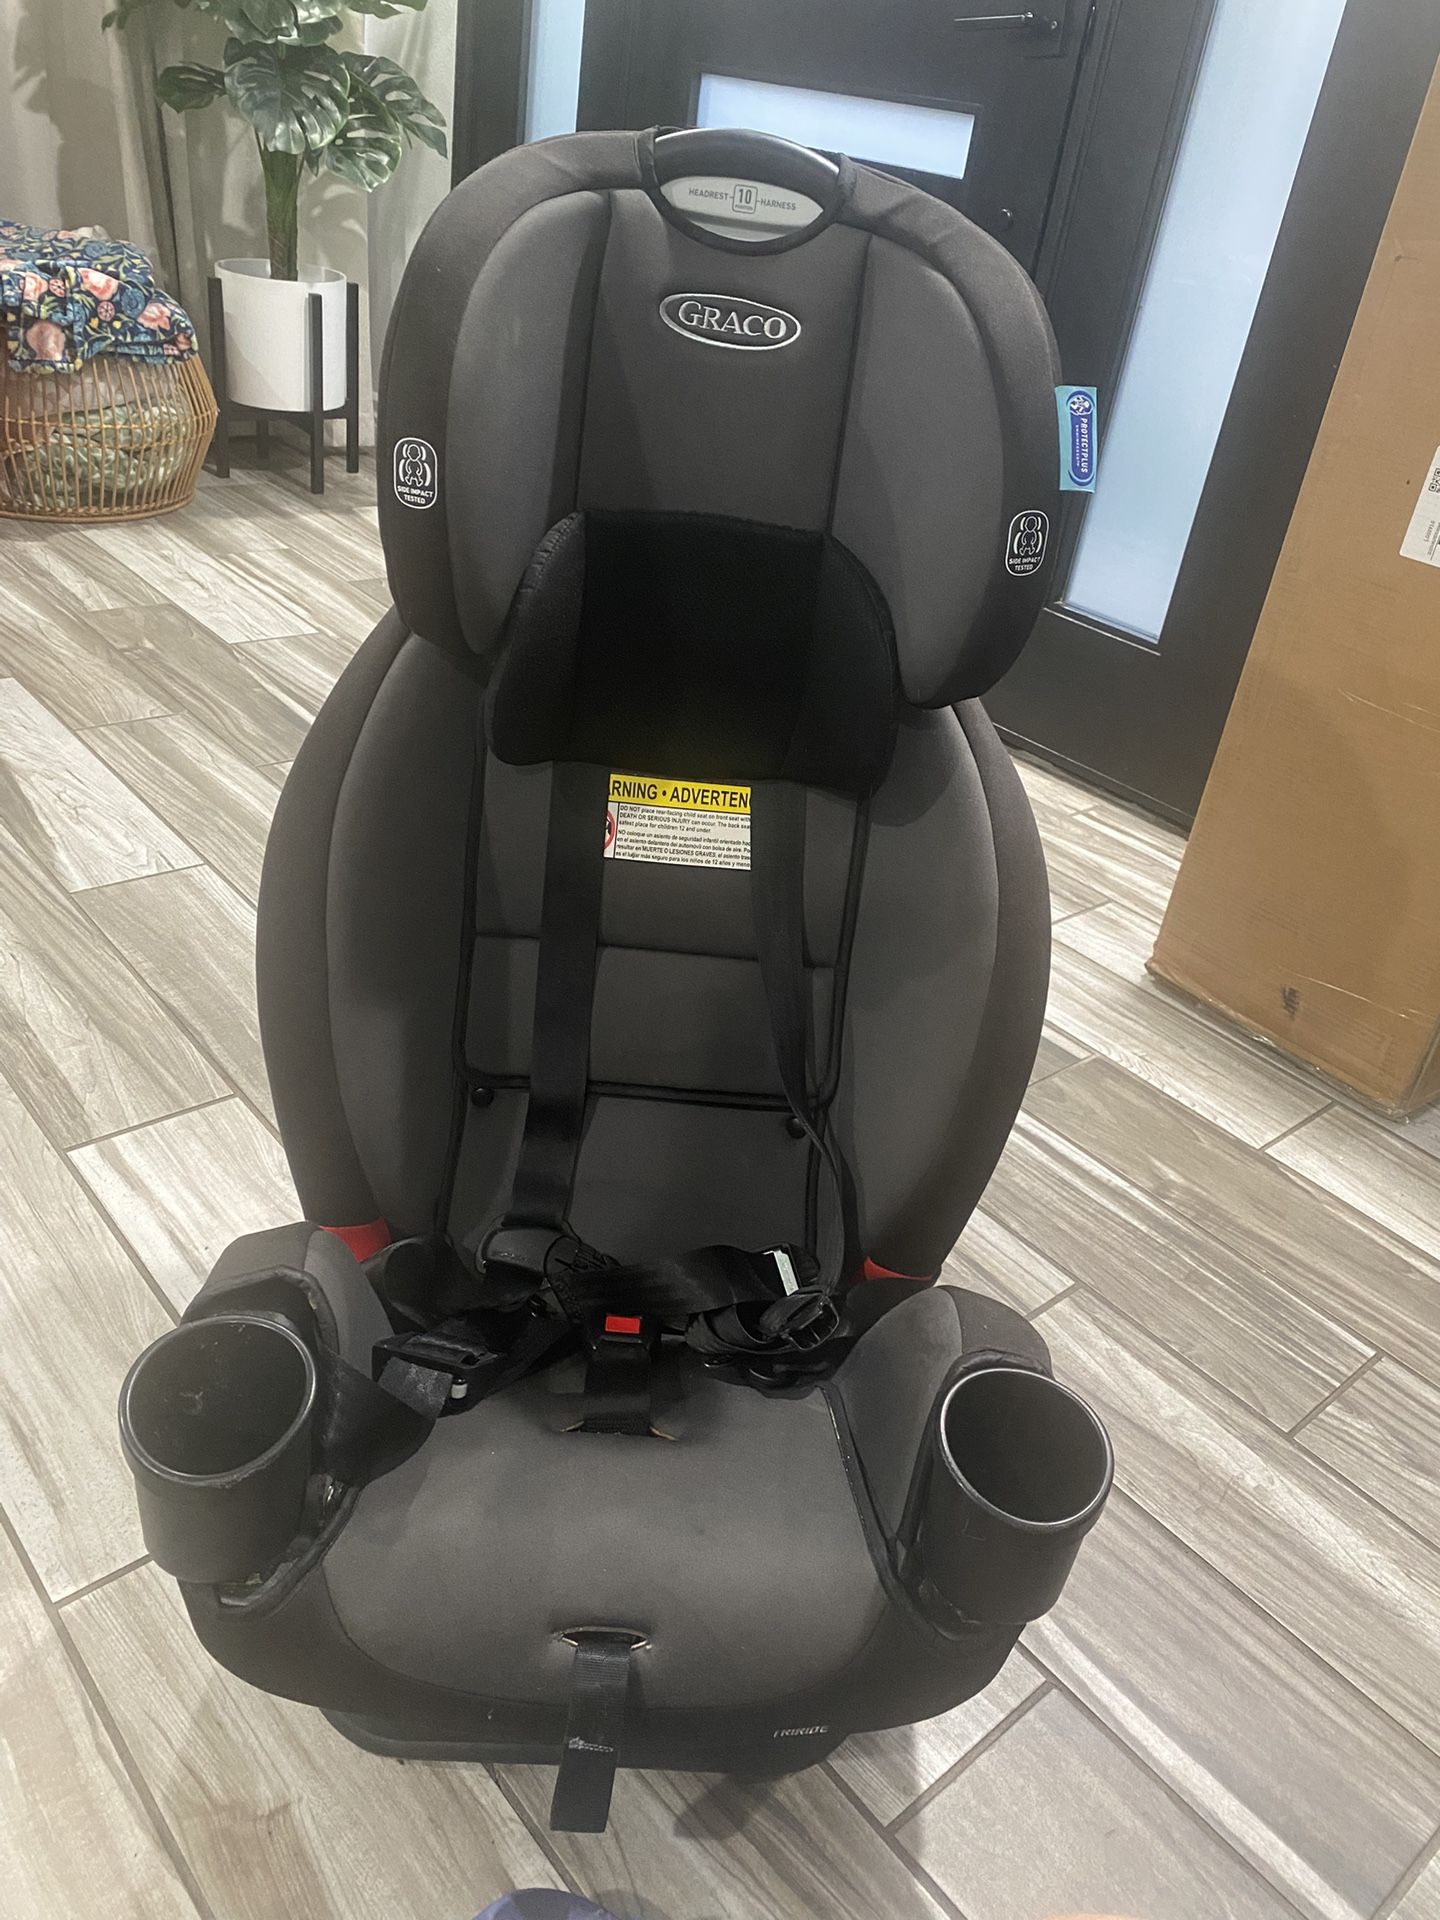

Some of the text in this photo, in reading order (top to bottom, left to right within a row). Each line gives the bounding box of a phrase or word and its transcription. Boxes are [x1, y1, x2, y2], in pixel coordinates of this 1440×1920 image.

[688, 188, 728, 200] HEADREST
[739, 188, 752, 204] 10
[760, 198, 796, 210] HARNESS
[678, 300, 787, 339] GRACO
[1080, 417, 1088, 473] PROTECTPLUS
[398, 486, 433, 498] SIDE IMPACT
[404, 494, 426, 504] TESTED
[612, 780, 750, 808] RNING ADVERTEN
